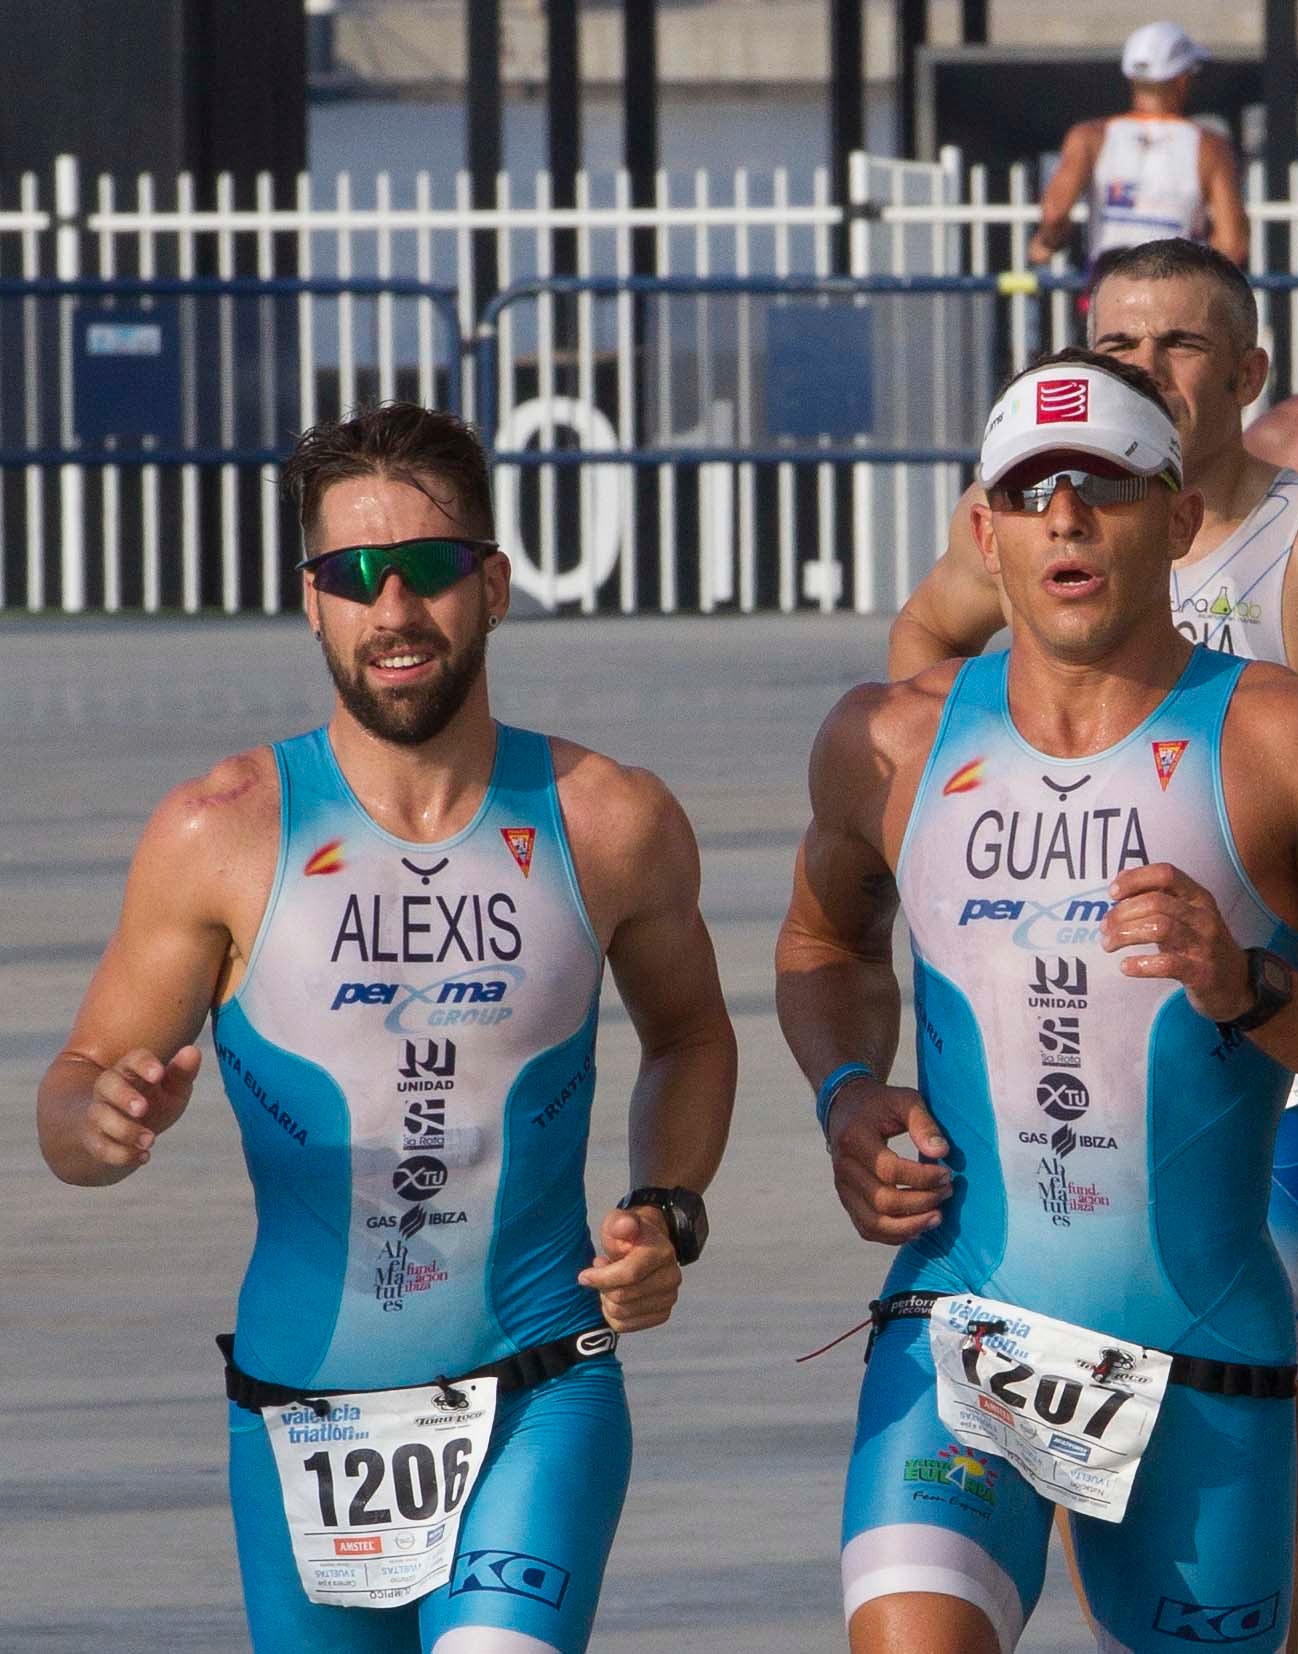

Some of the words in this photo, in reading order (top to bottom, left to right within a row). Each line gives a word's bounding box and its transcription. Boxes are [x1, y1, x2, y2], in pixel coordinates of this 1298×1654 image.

[966, 807, 1150, 880] GUAITA
[330, 893, 522, 963] ALEXIS
[1028, 997, 1088, 1010] UNIDAD
[427, 1007, 513, 1027] GROUP
[397, 1080, 455, 1093] UNIDAD
[1018, 1131, 1048, 1145] GAS
[1080, 1135, 1118, 1150] IBIZA
[366, 1216, 397, 1229] GAS
[428, 1211, 468, 1225] IBIZA
[962, 1348, 1136, 1440] 1207
[303, 1436, 473, 1527] 1206
[340, 1540, 375, 1552] AMSTEL
[315, 1569, 350, 1578] VUELTAS
